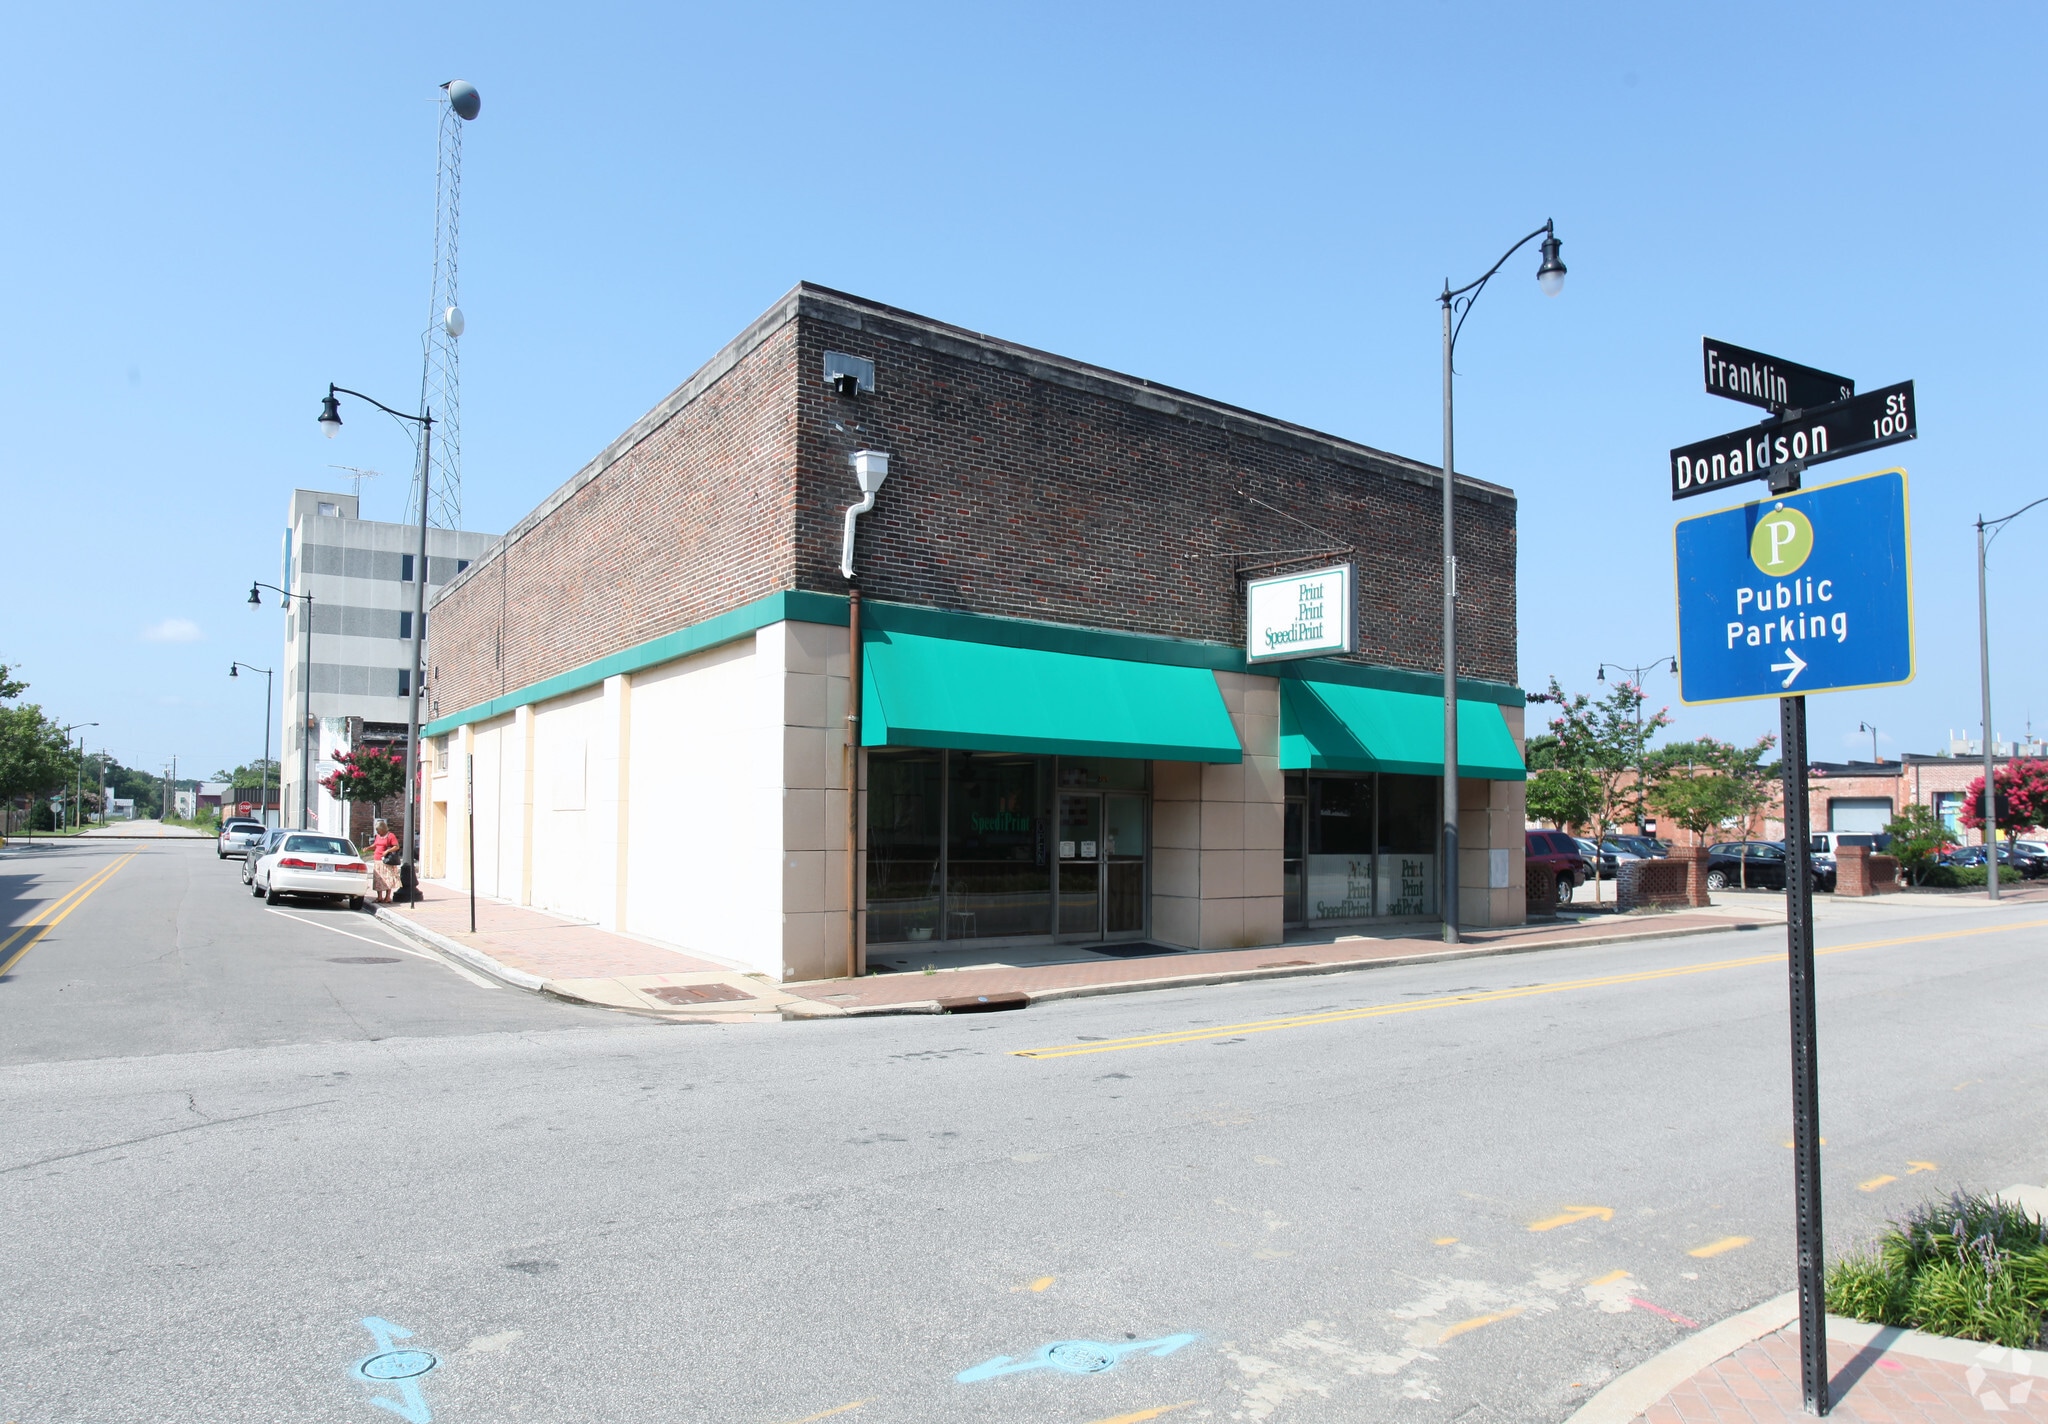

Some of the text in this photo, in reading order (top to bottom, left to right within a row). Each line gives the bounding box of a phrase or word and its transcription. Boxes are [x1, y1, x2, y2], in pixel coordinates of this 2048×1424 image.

[1707, 350, 1851, 404] Franklin St
[1676, 392, 1906, 490] Donaldson St
[1873, 412, 1908, 439] 100
[1765, 519, 1796, 566] P
[1299, 583, 1324, 602] Print
[1736, 577, 1833, 615] Public
[1299, 602, 1324, 621] Print
[1727, 611, 1847, 649] Parking
[1347, 880, 1370, 899] Print
[1402, 879, 1424, 897] Print
